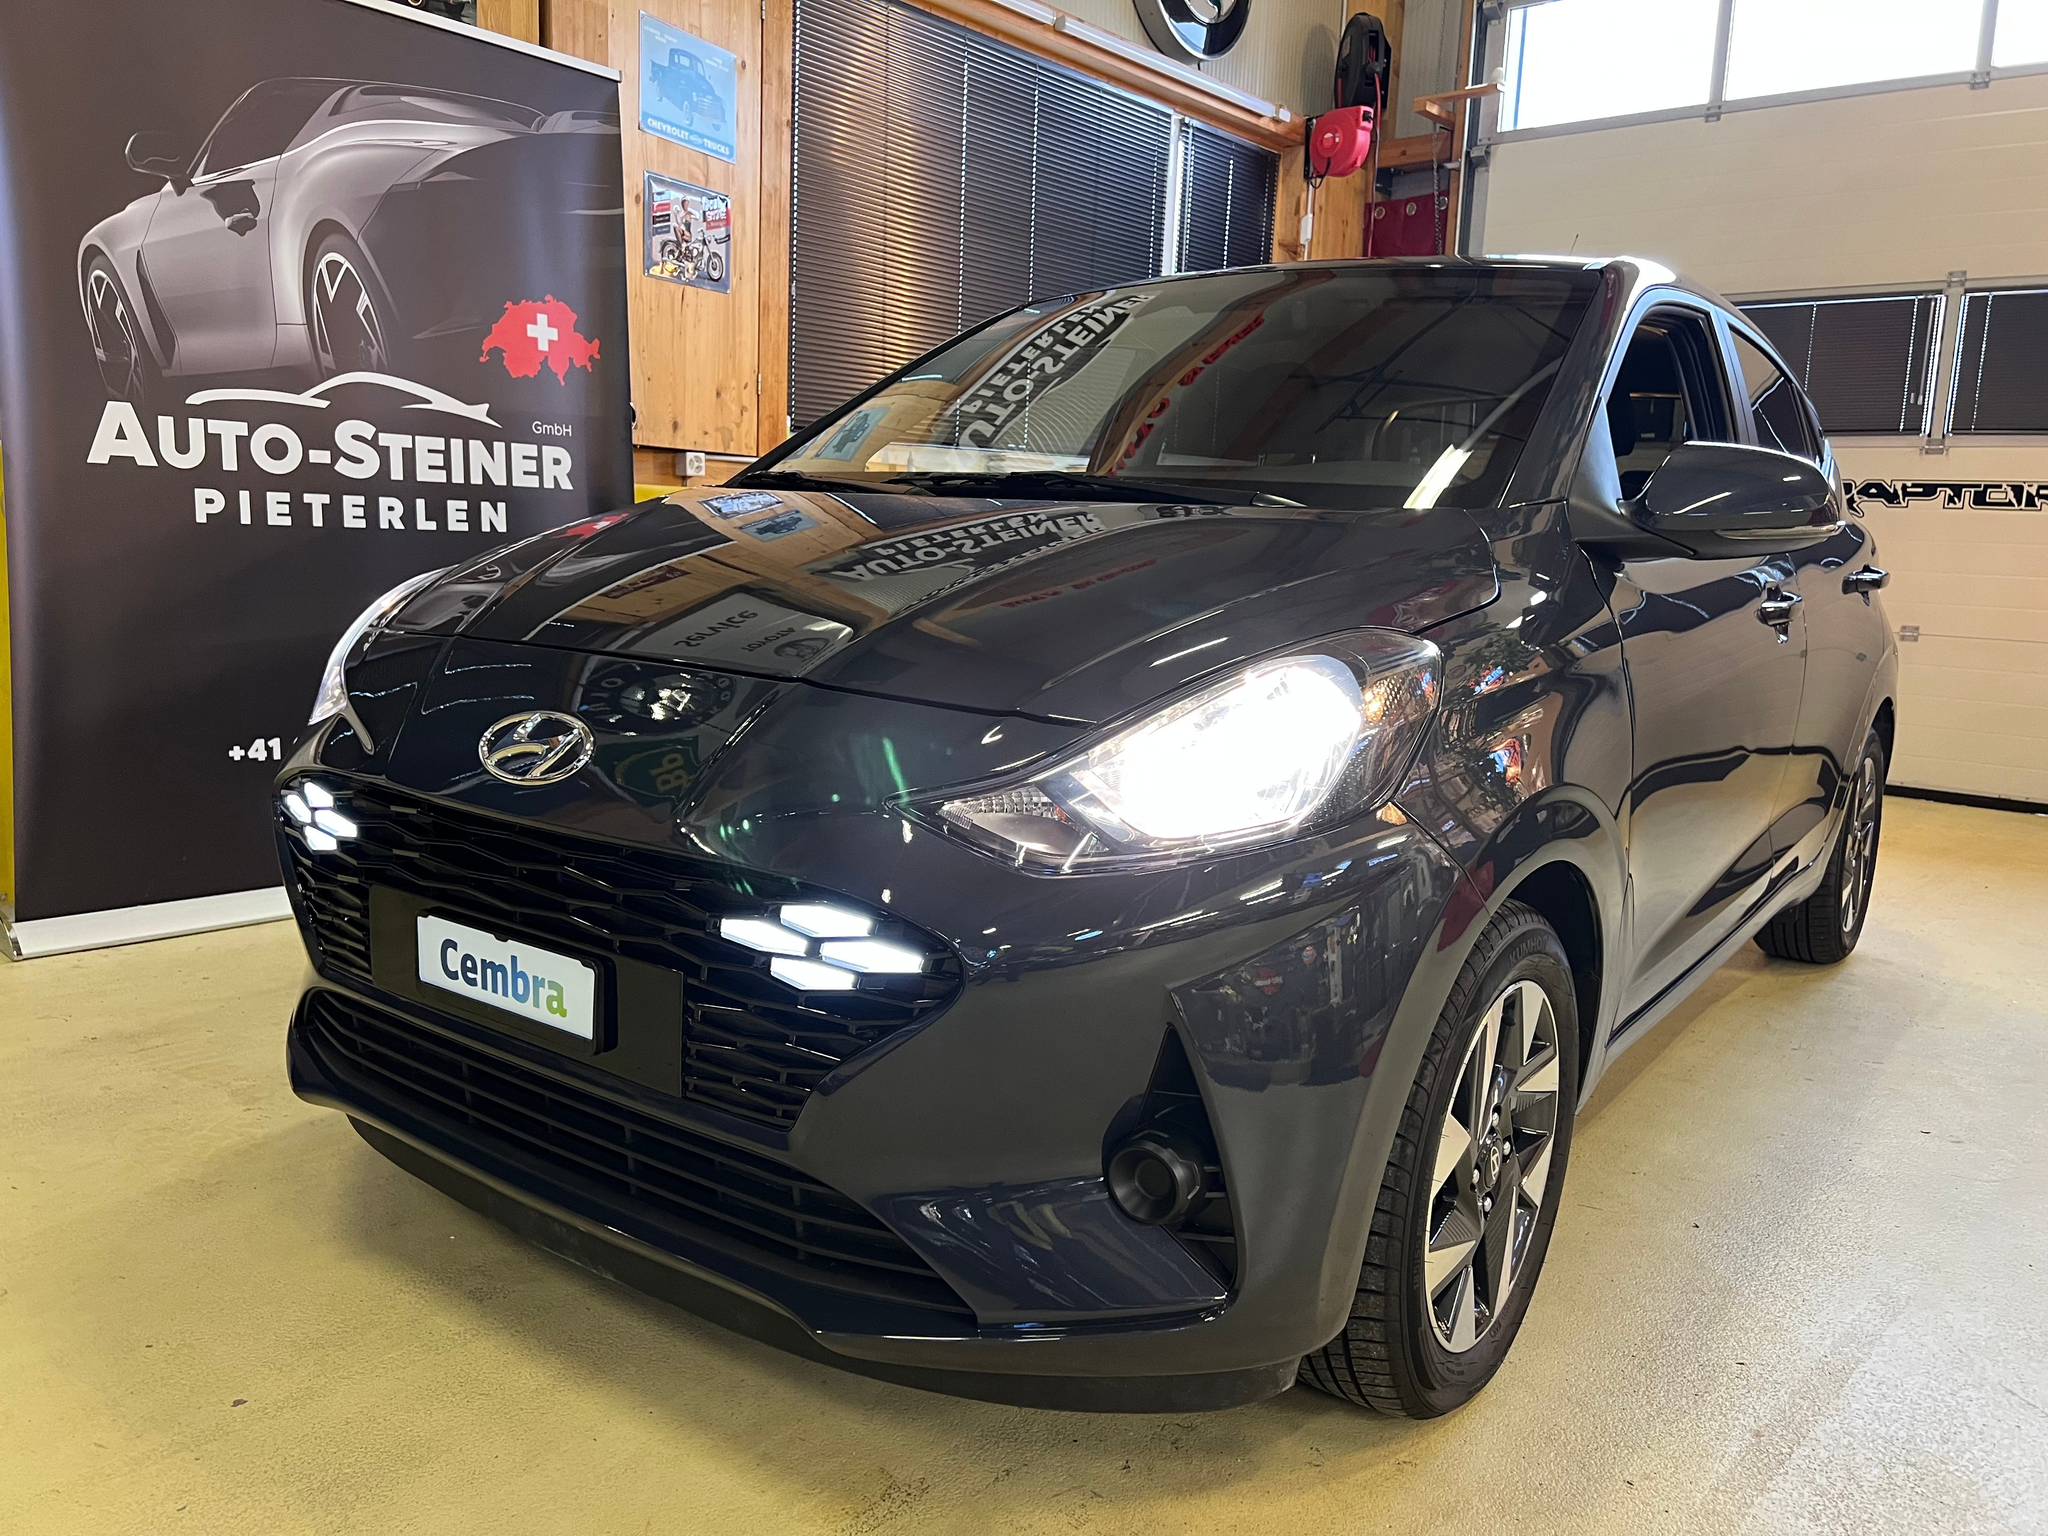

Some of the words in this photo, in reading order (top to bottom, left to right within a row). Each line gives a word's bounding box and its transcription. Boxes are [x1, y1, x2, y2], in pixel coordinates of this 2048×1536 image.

[647, 117, 689, 141] CHEVROLET
[703, 138, 730, 156] TRUCKS
[86, 400, 574, 490] AUTO-STEINER
[531, 421, 573, 437] GmbH
[194, 488, 508, 533] PIETERLEN
[228, 737, 282, 762] +41
[1509, 935, 1544, 967] KUMHO
[440, 938, 568, 1018] Cembra
